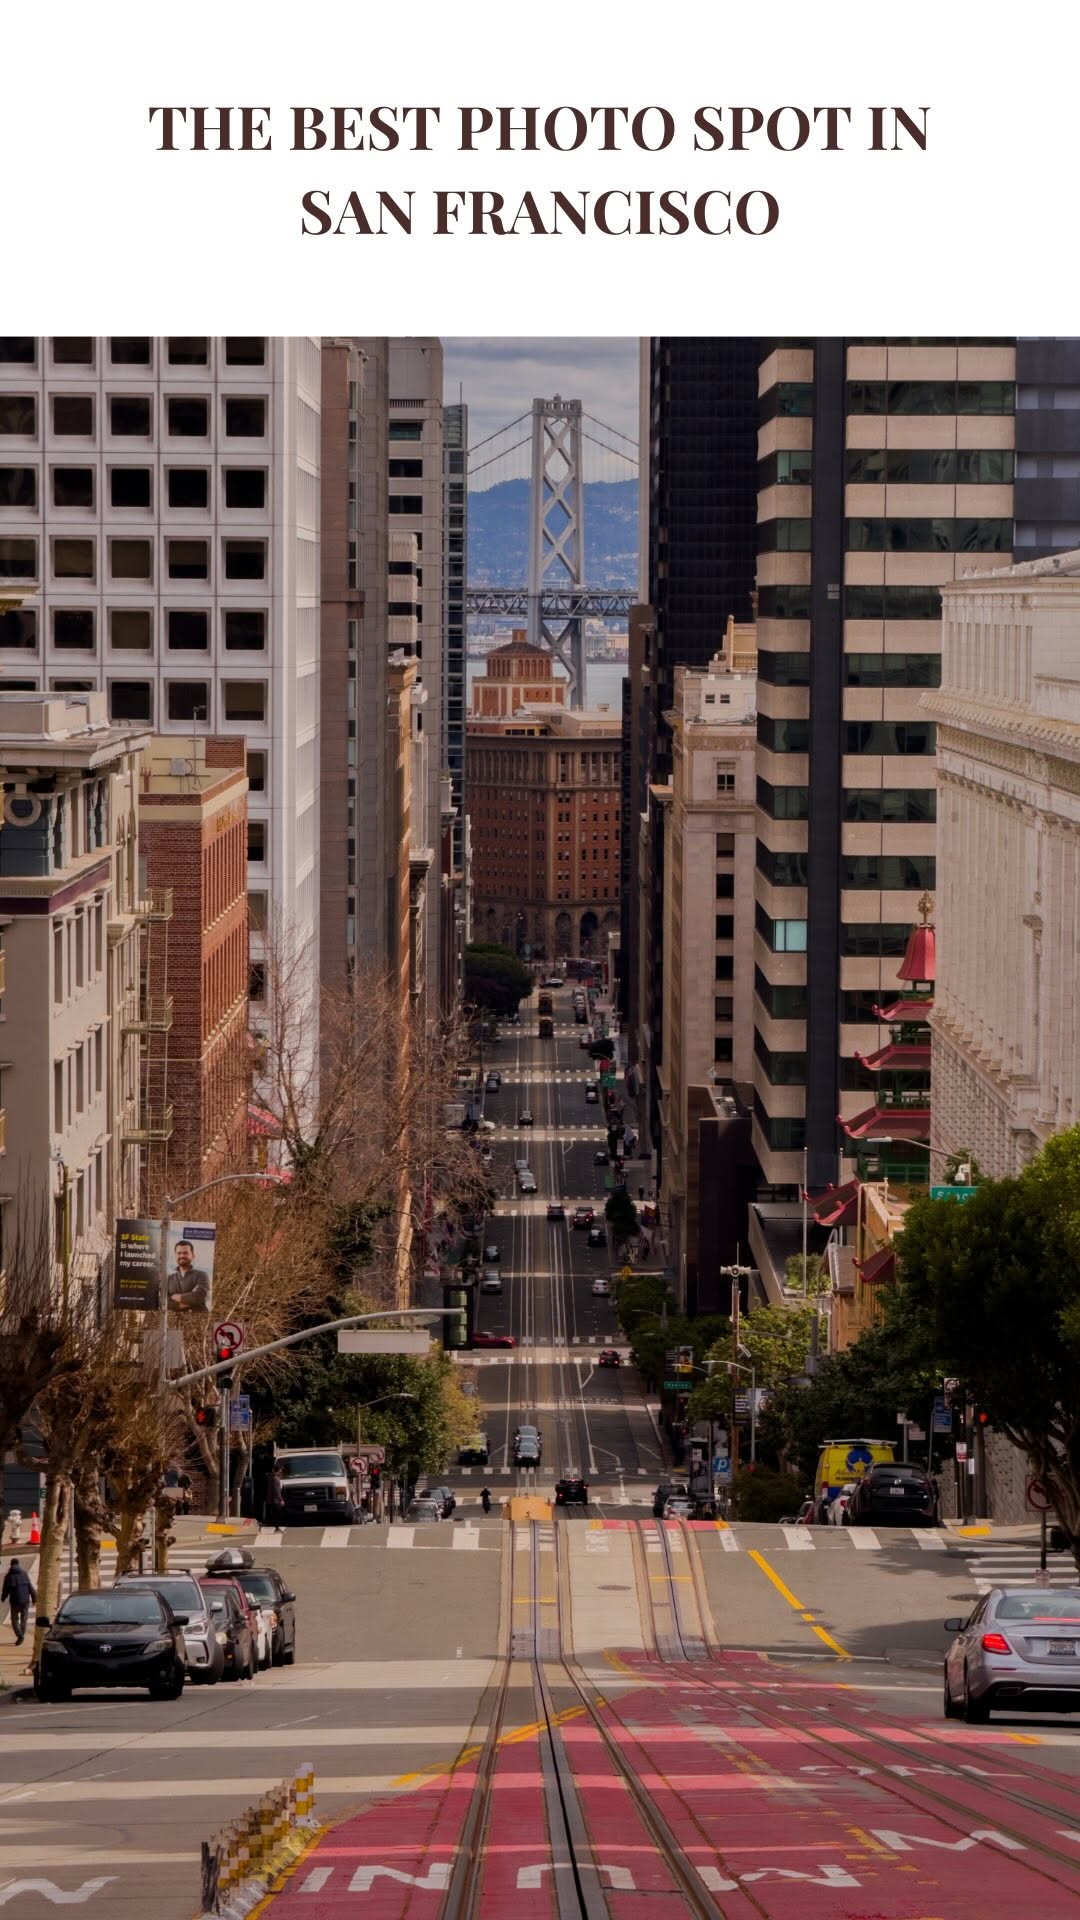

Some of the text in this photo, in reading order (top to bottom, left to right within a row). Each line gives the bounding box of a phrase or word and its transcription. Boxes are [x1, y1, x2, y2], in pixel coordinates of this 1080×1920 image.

[121, 1233, 150, 1242] SF State
[124, 1251, 156, 1259] launched
